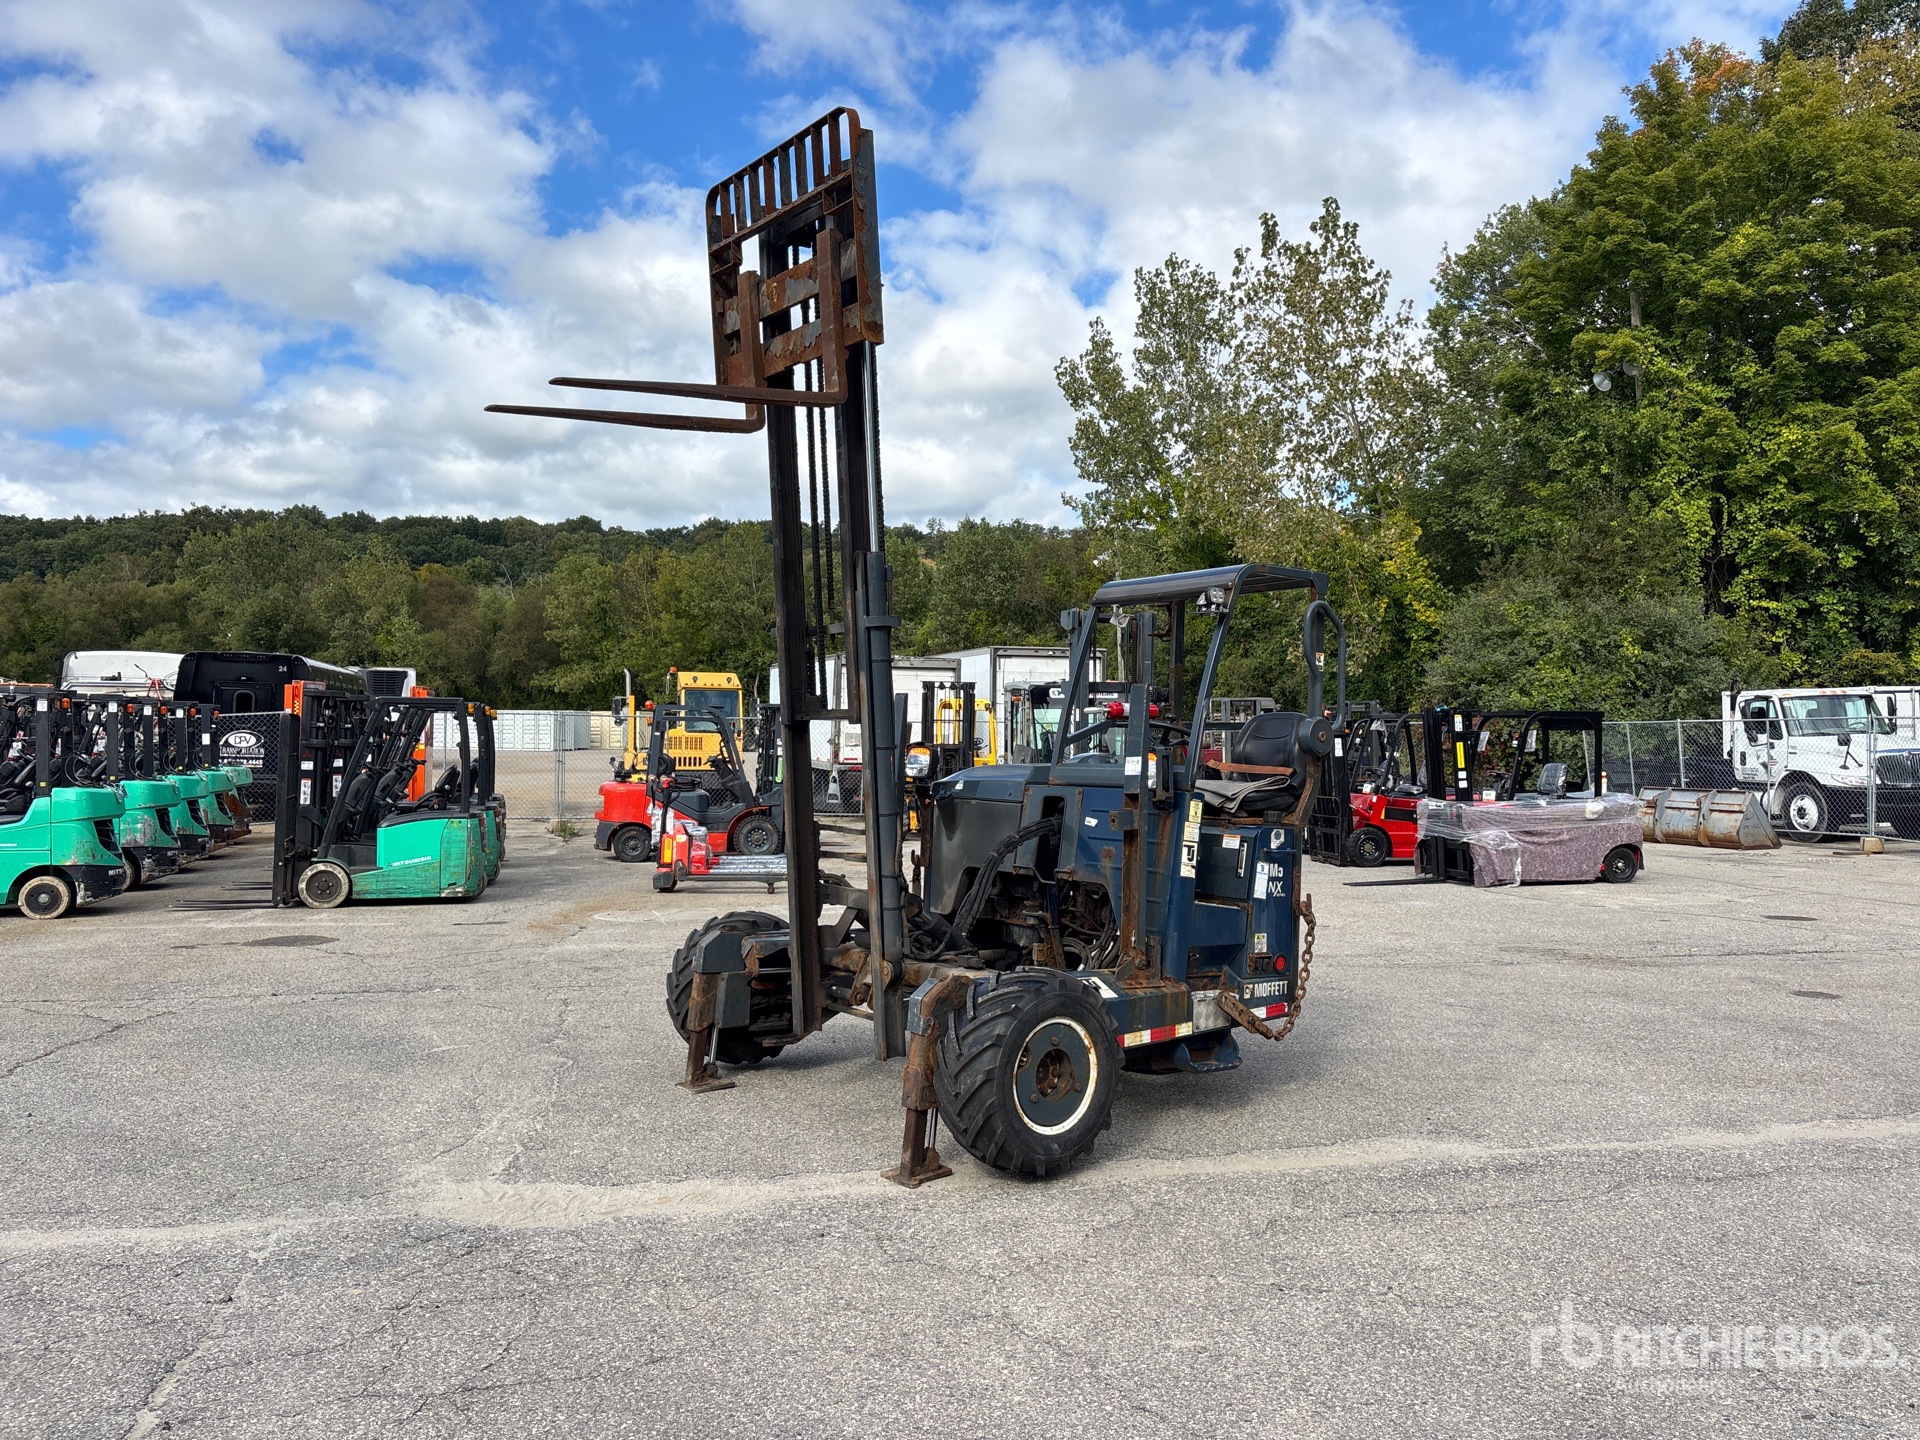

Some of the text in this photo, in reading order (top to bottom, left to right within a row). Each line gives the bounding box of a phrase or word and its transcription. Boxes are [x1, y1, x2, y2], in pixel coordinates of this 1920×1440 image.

[234, 735, 252, 745] DPV
[392, 855, 432, 867] MITSUBISHI
[1267, 881, 1284, 897] NX
[1254, 981, 1289, 998] MOFFETT
